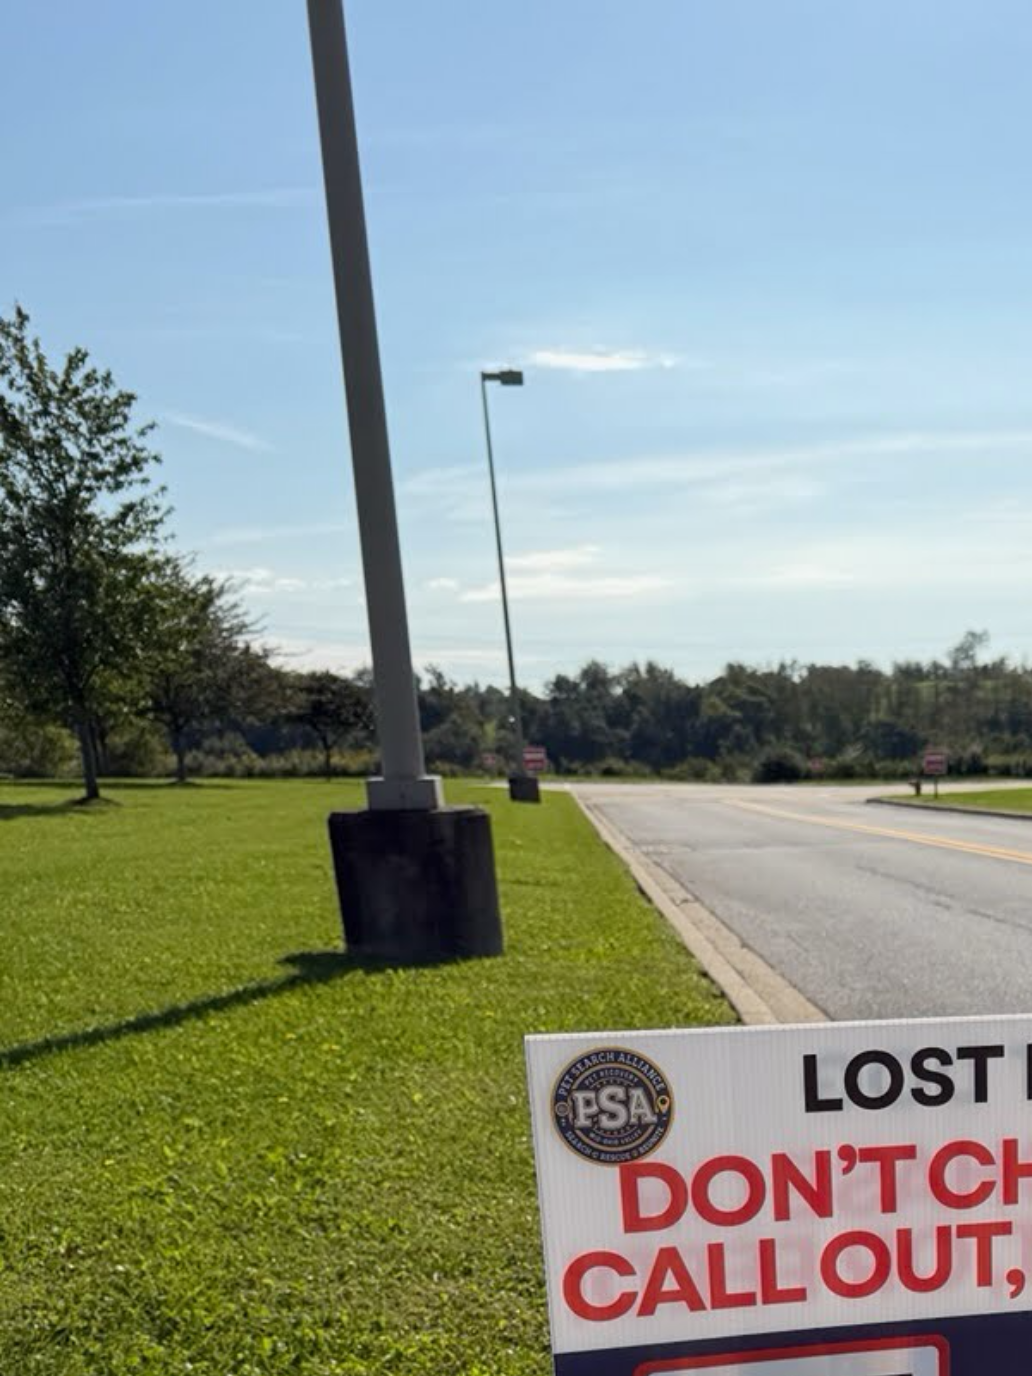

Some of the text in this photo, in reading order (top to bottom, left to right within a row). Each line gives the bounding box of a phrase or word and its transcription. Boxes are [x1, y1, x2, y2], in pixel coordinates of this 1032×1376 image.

[558, 1051, 666, 1096] PET SEARCH ALLIANCE
[572, 1084, 658, 1130] PSA
[803, 1044, 1005, 1113] LOST
[618, 1143, 917, 1234] DON'T
[562, 1238, 807, 1322] CALL
[820, 1221, 1026, 1299] OUT,
